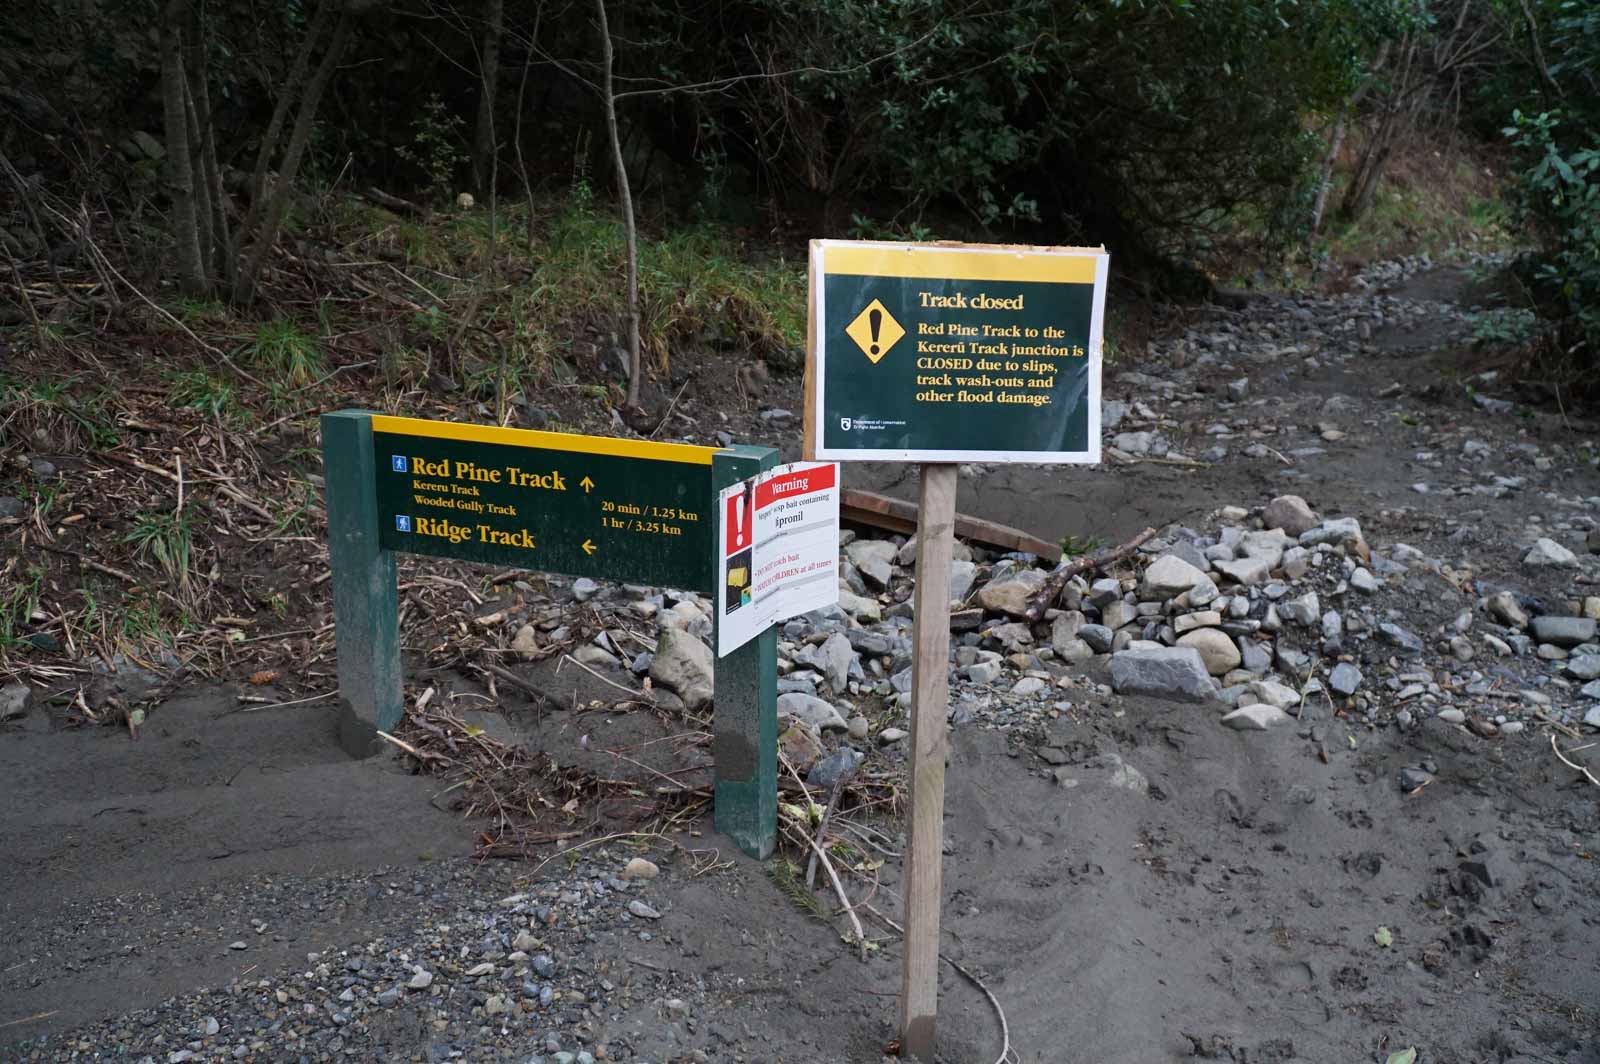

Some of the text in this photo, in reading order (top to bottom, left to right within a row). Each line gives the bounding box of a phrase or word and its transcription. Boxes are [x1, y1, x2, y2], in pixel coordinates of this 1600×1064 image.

[919, 292, 1024, 310] Track closed
[918, 323, 1065, 339] Red Pine Track to the
[969, 342, 1008, 355] Track
[1011, 343, 1069, 358] junction
[1072, 345, 1084, 357] is
[917, 358, 1058, 375] CLOSED due to slips,
[916, 374, 1054, 388] track wash-outs and
[916, 389, 1052, 406] other flood damage.
[411, 457, 567, 491] Red Pine Track
[413, 480, 480, 496] Kereru Track
[413, 495, 517, 516] Wooded Gully Track
[798, 494, 830, 507] containing
[601, 501, 698, 521] 20 min / 1.25 km
[775, 510, 803, 528] ipronil
[415, 517, 536, 549] Ridge Track
[602, 517, 682, 535] 1 hr / 3.25 km
